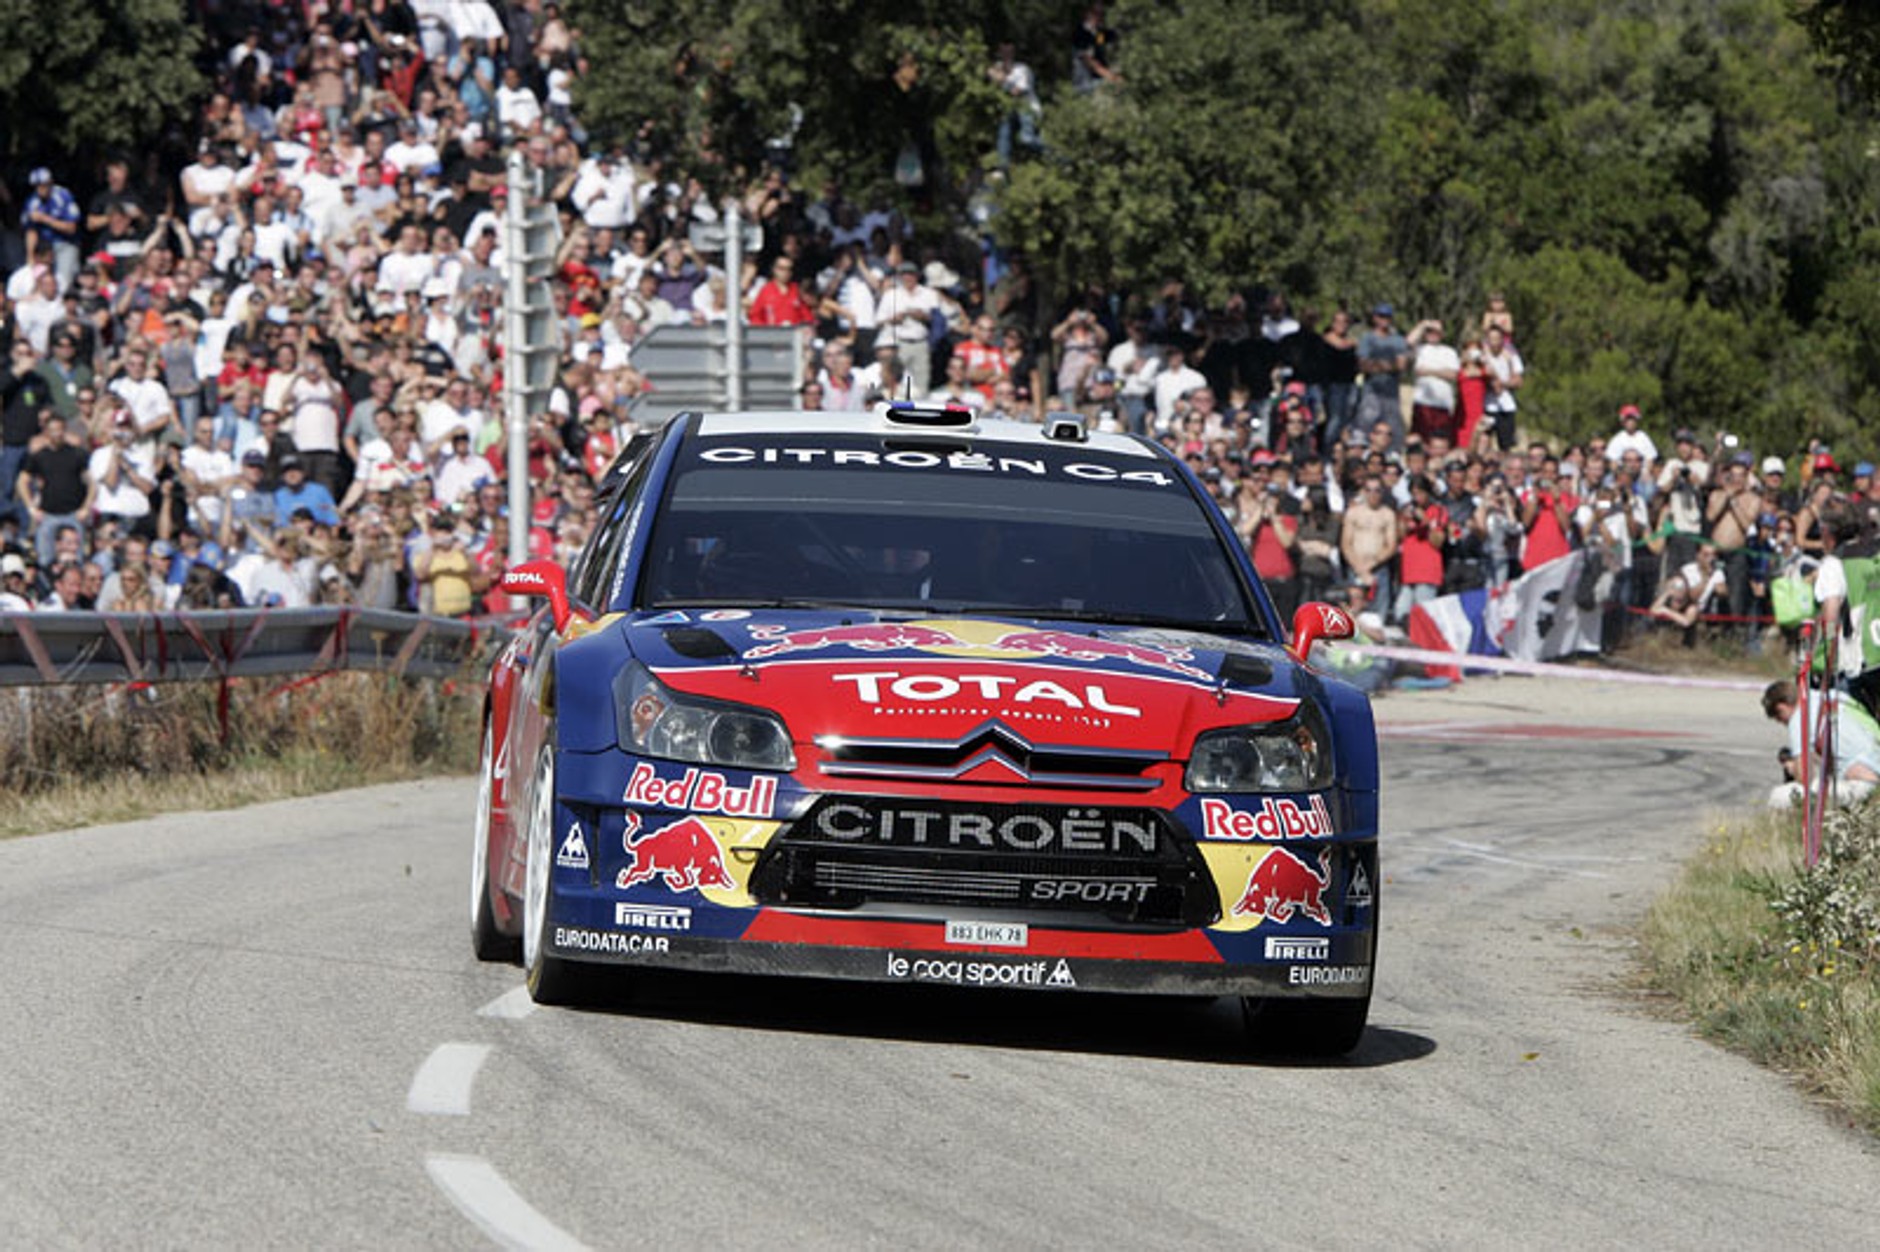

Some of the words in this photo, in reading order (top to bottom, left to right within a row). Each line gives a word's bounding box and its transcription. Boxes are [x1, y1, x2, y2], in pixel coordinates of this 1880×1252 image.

[699, 447, 1046, 474] CITROËN
[1063, 463, 1172, 486] C4
[504, 573, 544, 584] TOTAL
[832, 671, 1142, 718] TOTAL
[623, 761, 699, 809] Red
[690, 771, 778, 817] Bull
[817, 803, 1156, 851] CITROËN
[1201, 797, 1282, 839] Red
[1276, 794, 1333, 839] Bull
[1031, 881, 1157, 902] SPORT
[615, 902, 692, 930] PIRELLI
[555, 928, 669, 953] EURODATACAR
[1264, 937, 1329, 959] PIRELLI
[888, 952, 910, 976] le
[913, 959, 962, 984] coq
[965, 960, 1047, 985] sportif
